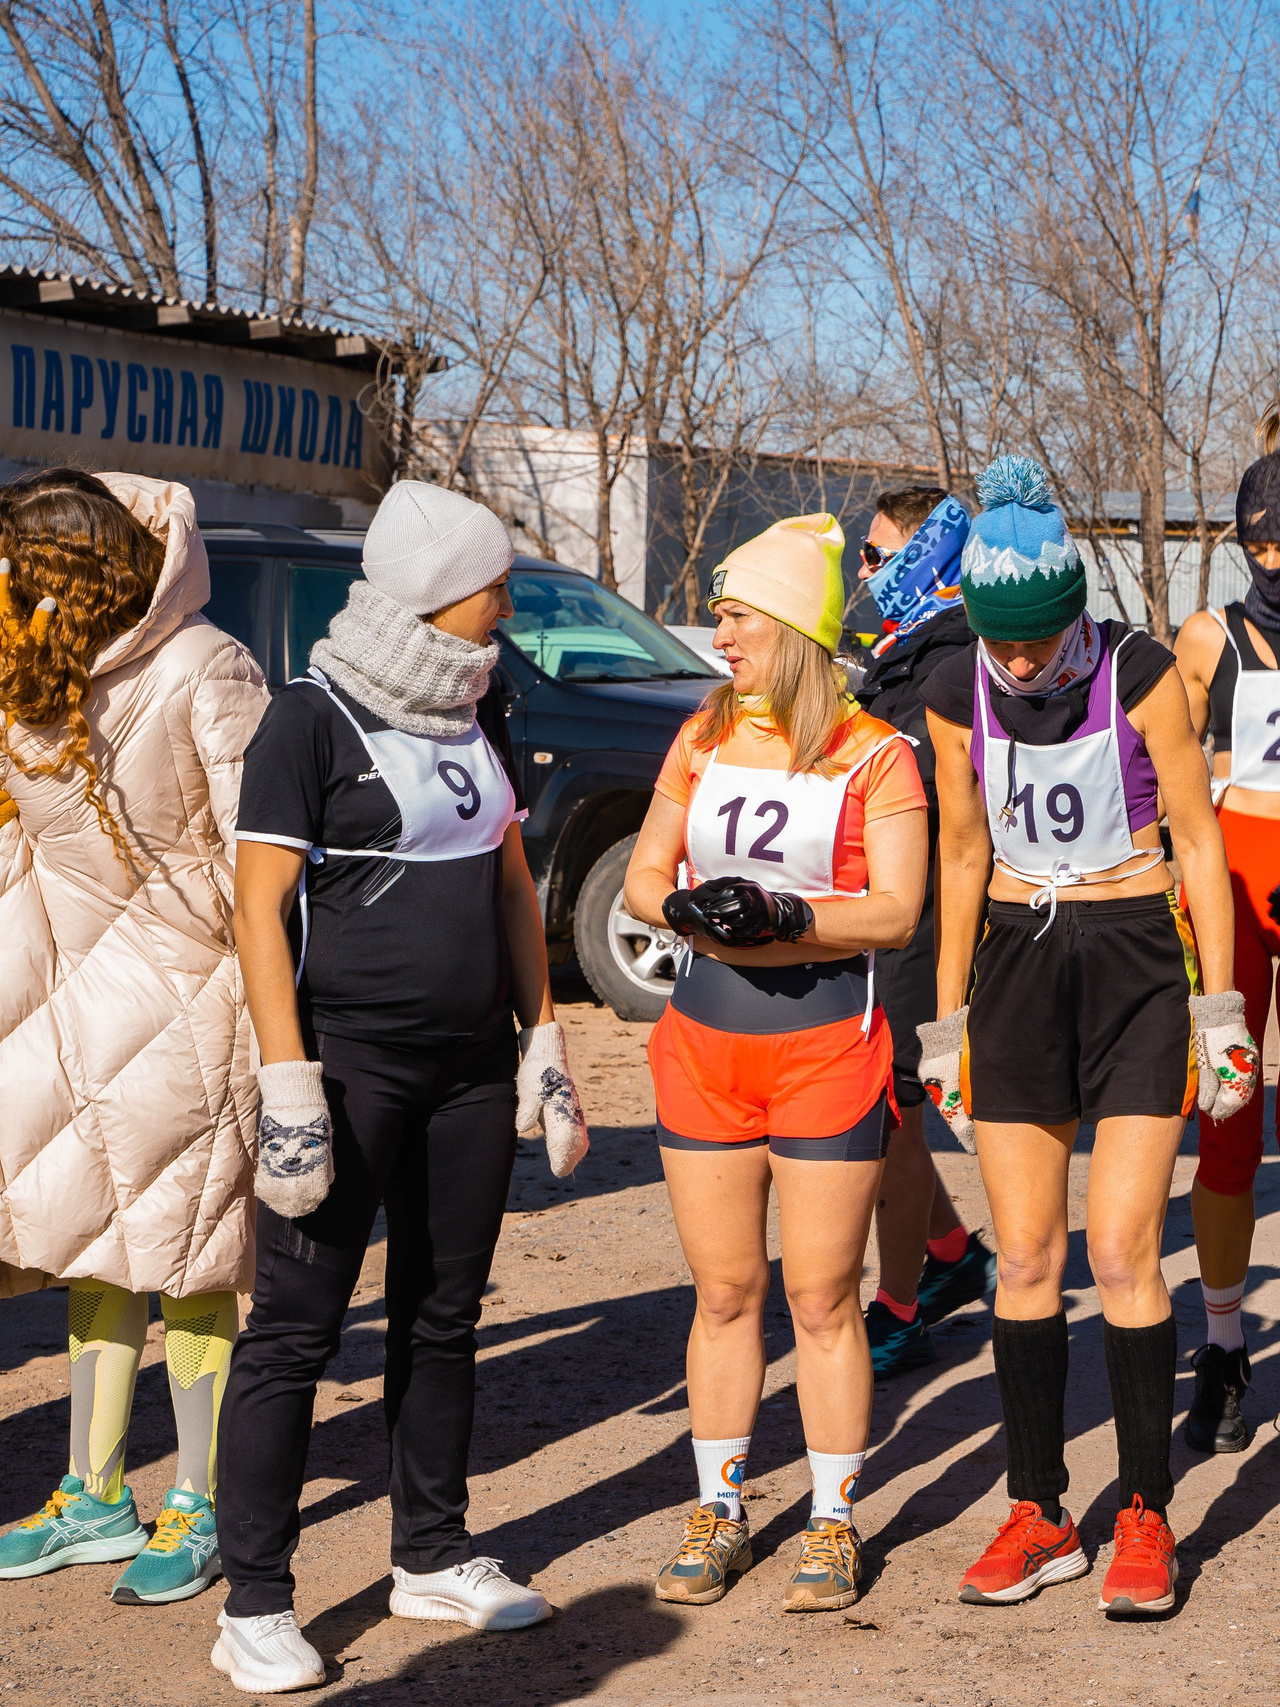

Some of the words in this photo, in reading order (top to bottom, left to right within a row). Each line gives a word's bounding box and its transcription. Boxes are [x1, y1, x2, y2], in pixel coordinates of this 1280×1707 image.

[11, 343, 224, 449] ПАРУСНАЯ
[240, 379, 363, 470] ШКОЛА
[438, 760, 482, 821] 9
[1011, 782, 1085, 844] 19
[716, 796, 789, 864] 12
